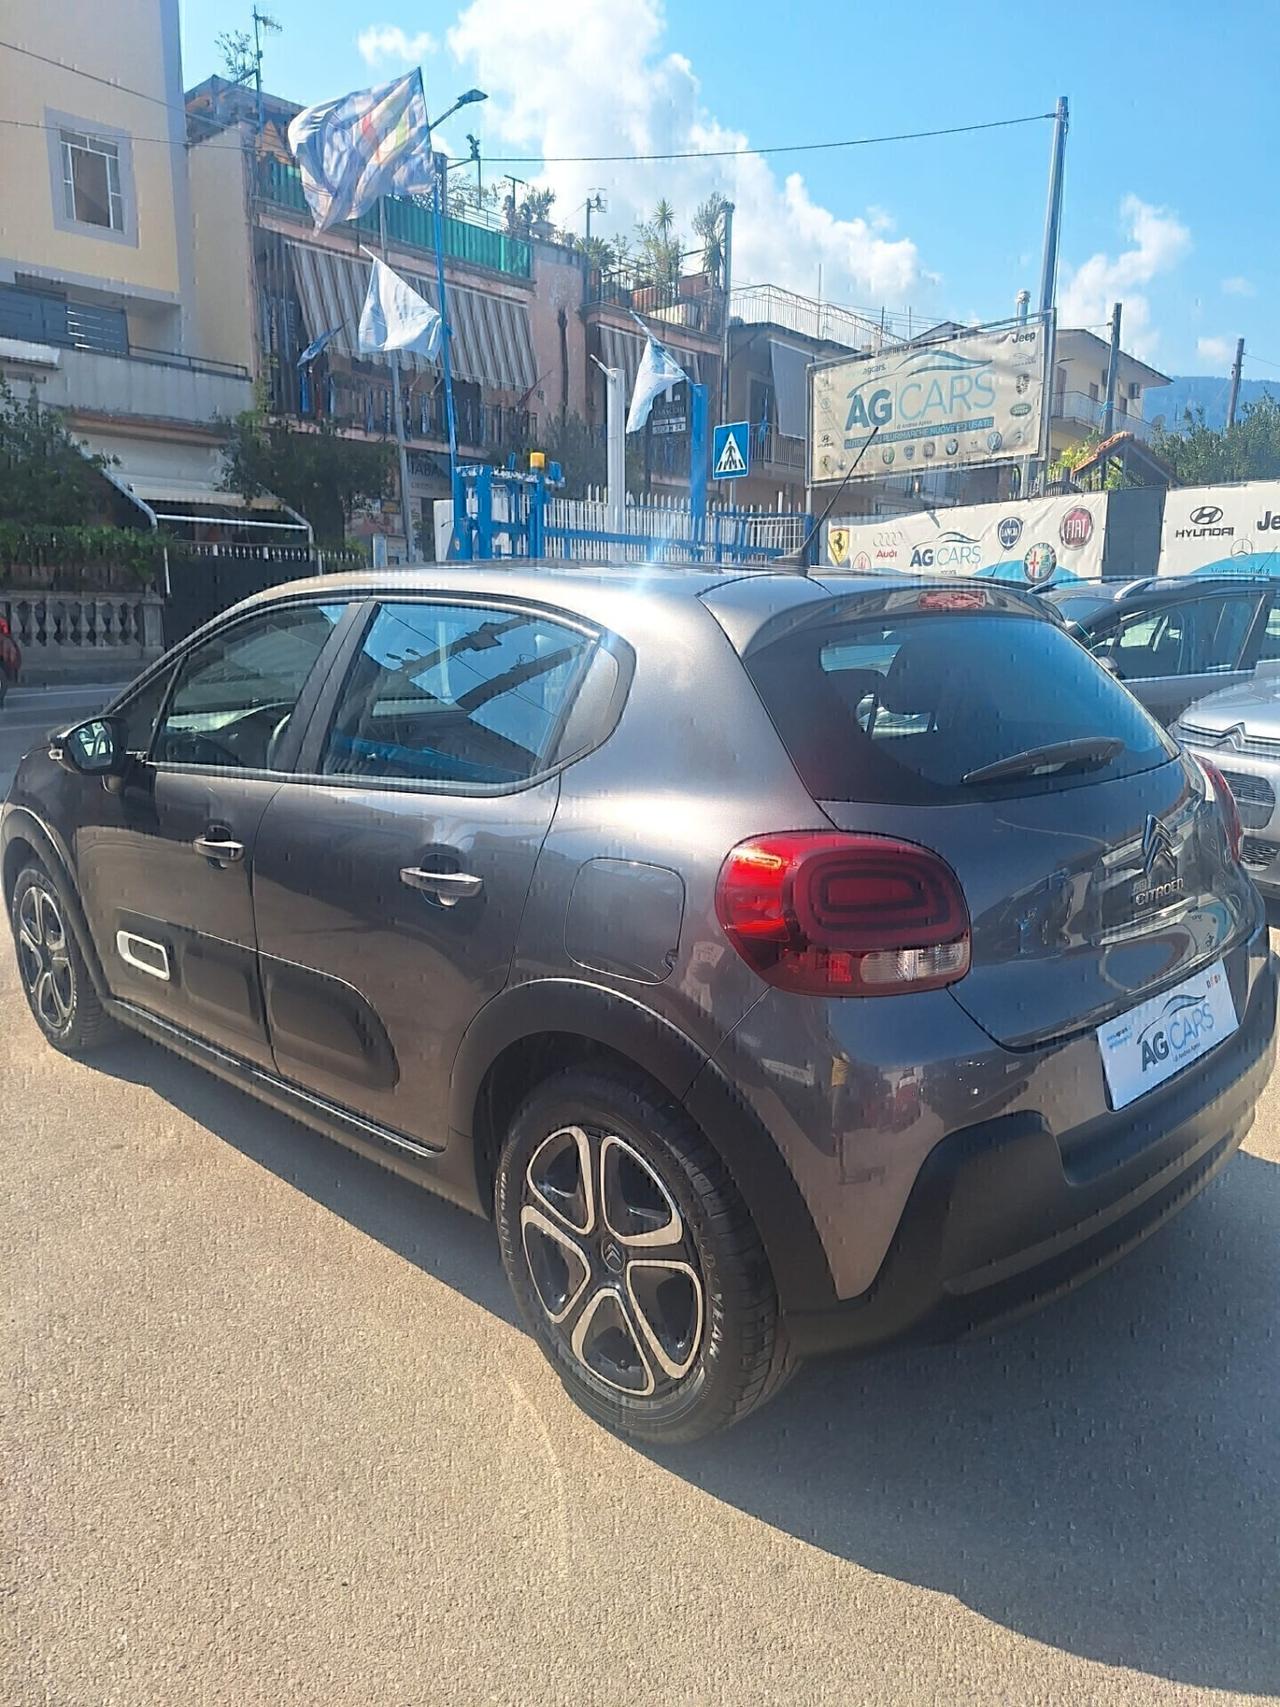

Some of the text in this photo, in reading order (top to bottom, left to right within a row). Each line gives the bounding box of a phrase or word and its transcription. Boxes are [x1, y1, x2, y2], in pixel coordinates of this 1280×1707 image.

[1012, 332, 1036, 343] Jeep
[845, 369, 996, 431] AG CARS
[846, 435, 881, 448] AUTOMILI
[1066, 519, 1088, 539] FIAT
[1175, 527, 1235, 538] HYUNDAI
[876, 550, 898, 559] Audi
[909, 545, 982, 567] AG CARS
[1142, 1031, 1170, 1072] AG
[1169, 1003, 1215, 1050] CARS
